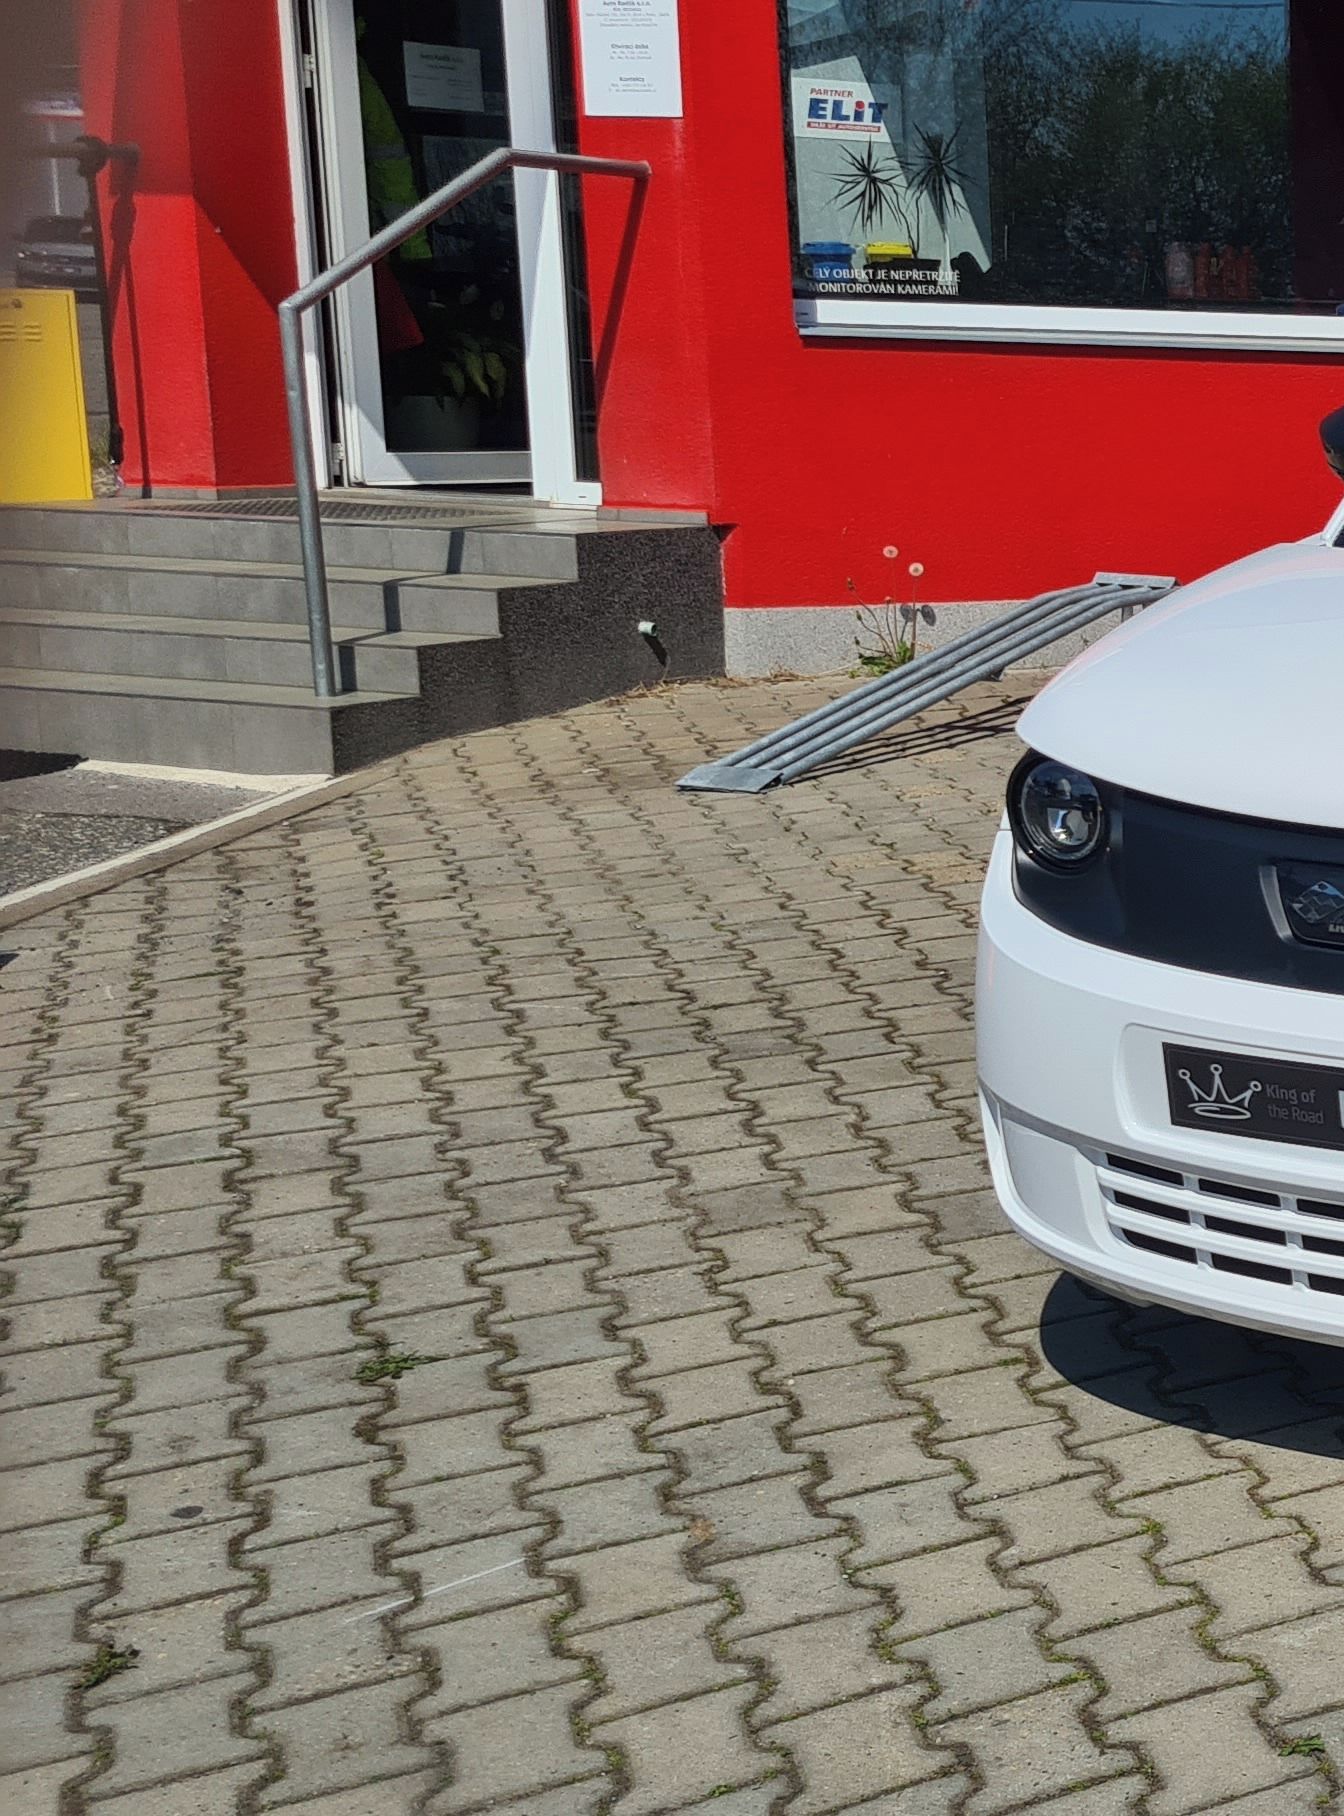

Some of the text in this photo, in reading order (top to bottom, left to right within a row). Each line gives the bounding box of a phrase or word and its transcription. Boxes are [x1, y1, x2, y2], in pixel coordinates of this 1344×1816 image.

[810, 87, 854, 98] PARTNER
[832, 268, 875, 280] OBJEKT
[876, 268, 888, 280] JE
[890, 268, 961, 283] NEPŘETRŽITĚ
[808, 281, 959, 296] MONITOROVÁN KAMERAMI!
[1266, 1084, 1316, 1105] King of
[1267, 1104, 1325, 1125] the Road
